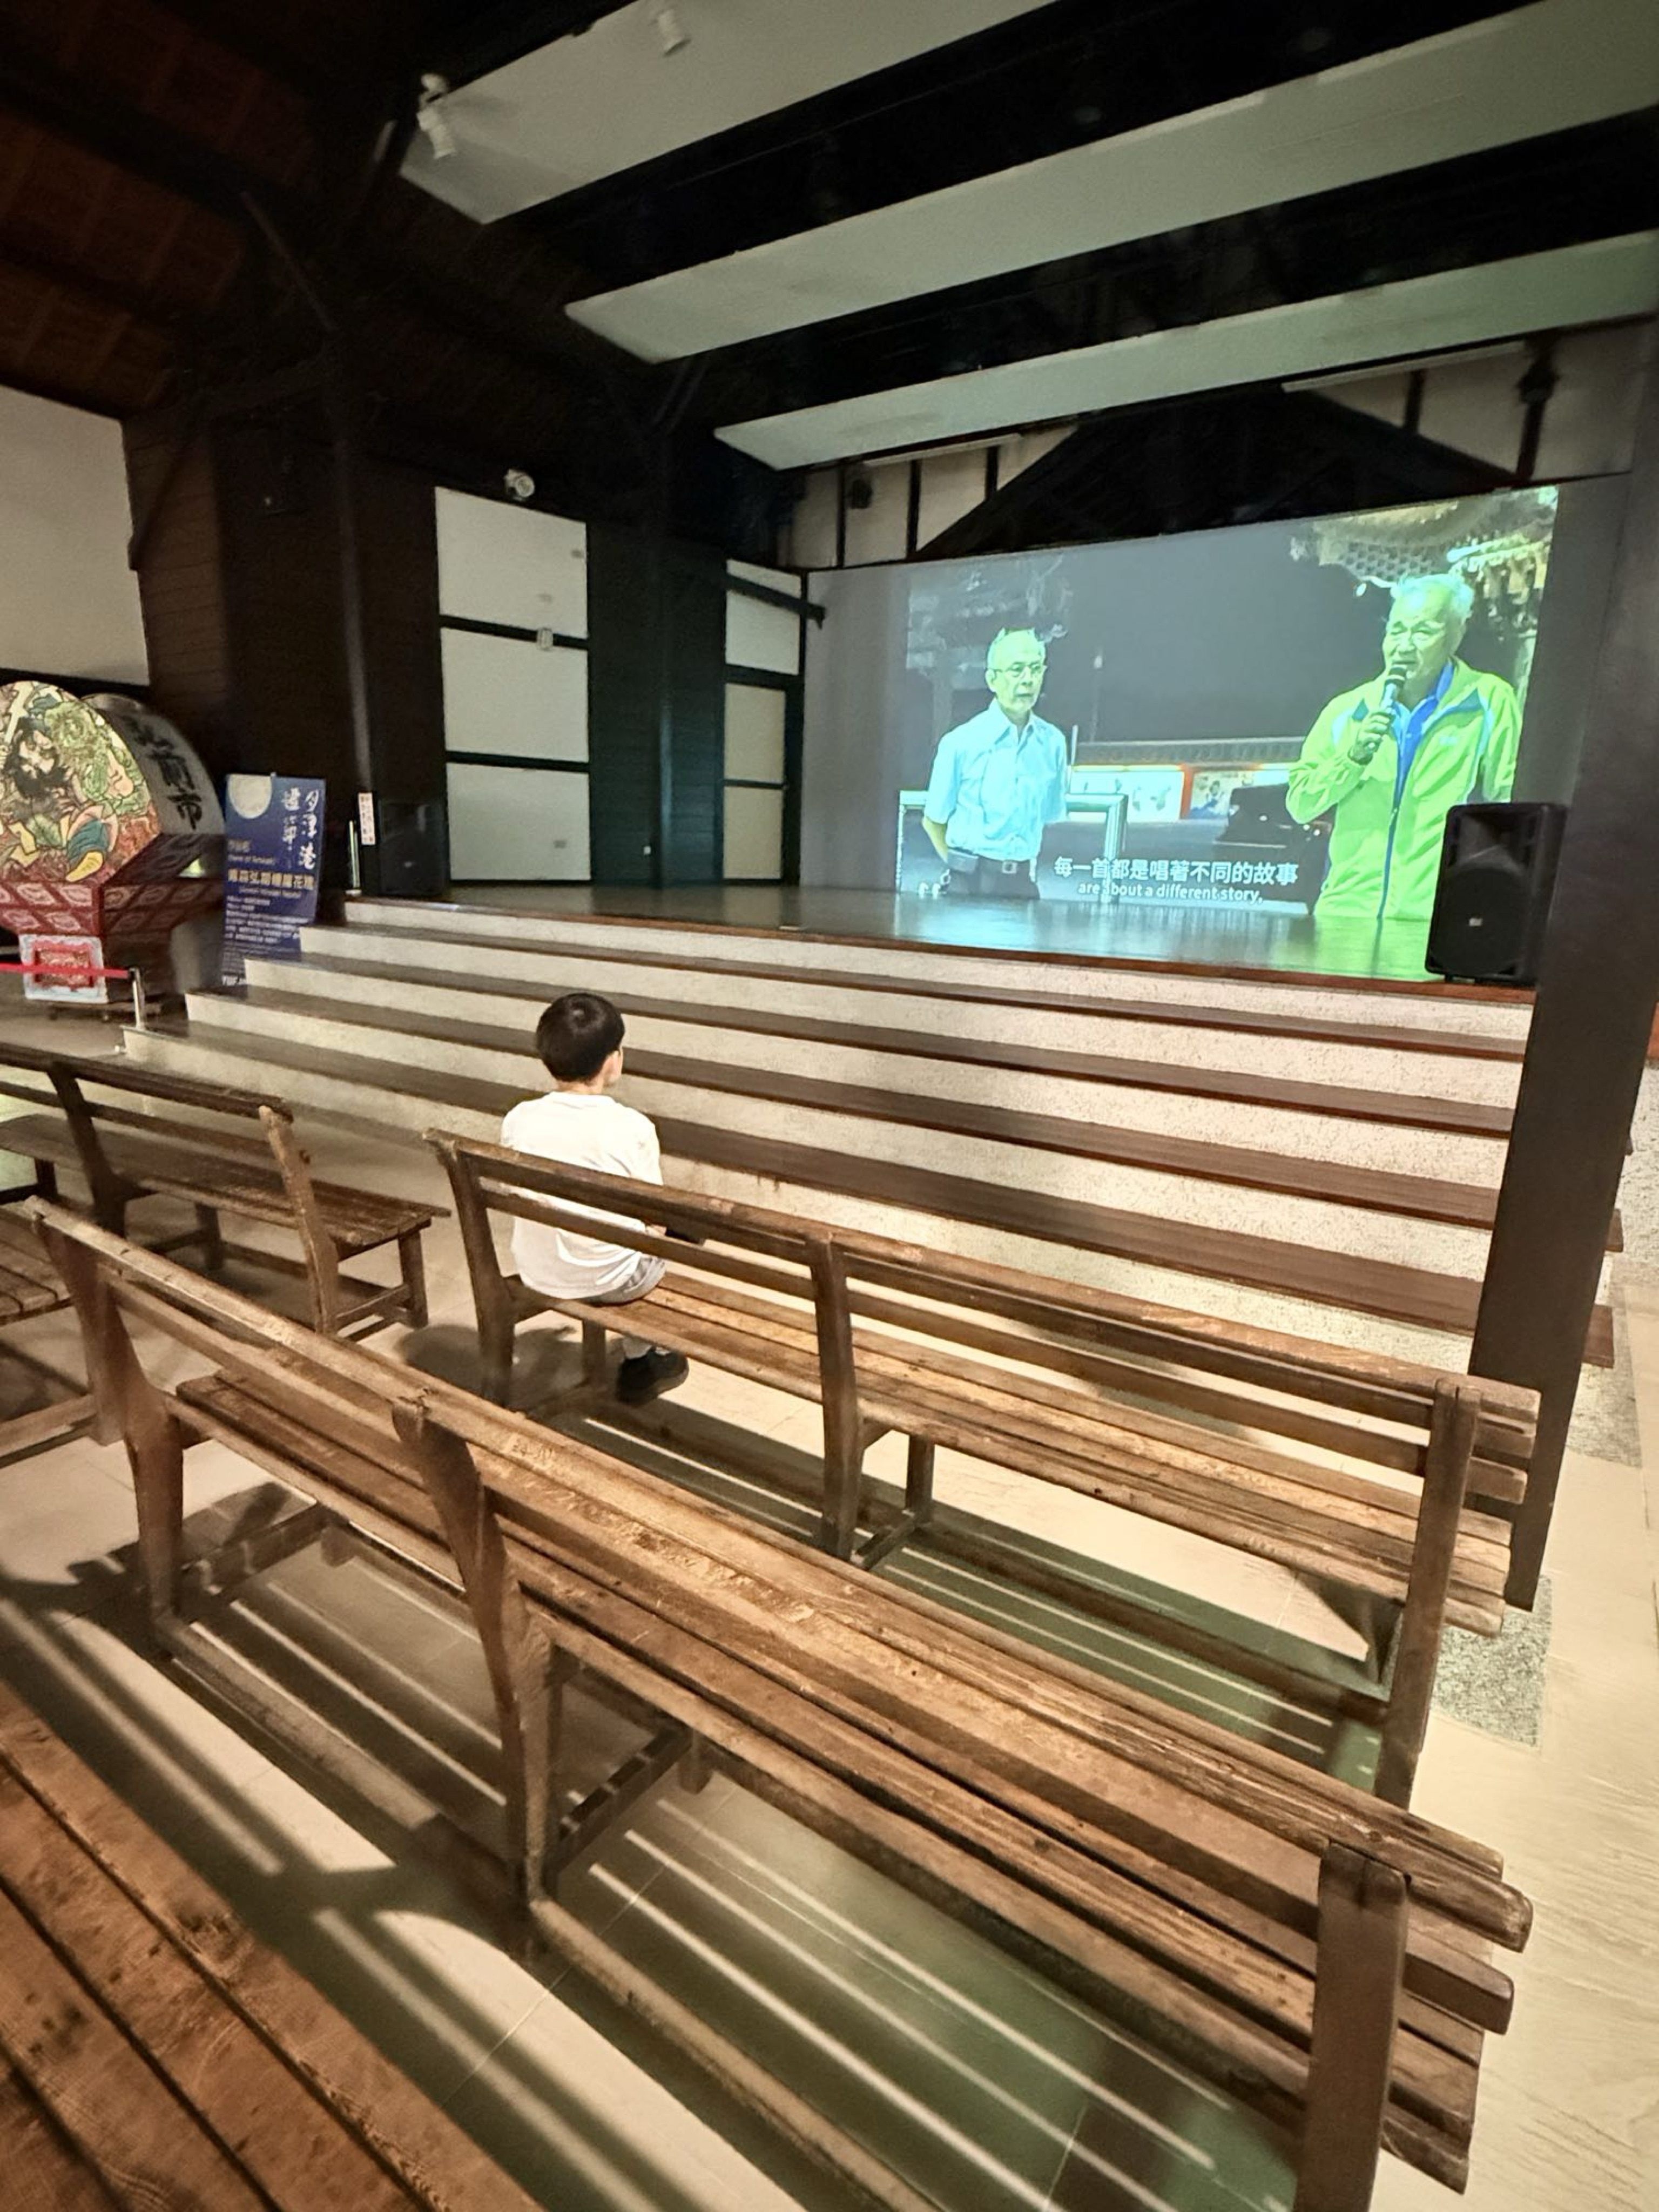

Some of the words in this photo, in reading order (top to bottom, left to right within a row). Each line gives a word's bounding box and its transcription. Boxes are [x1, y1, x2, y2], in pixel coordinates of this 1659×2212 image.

[1054, 855, 1299, 886] 每一首都是唱著不同的故事
[1078, 883, 1101, 895] are
[1103, 882, 1143, 896] about
[1145, 887, 1154, 896] a
[1156, 883, 1217, 900] different
